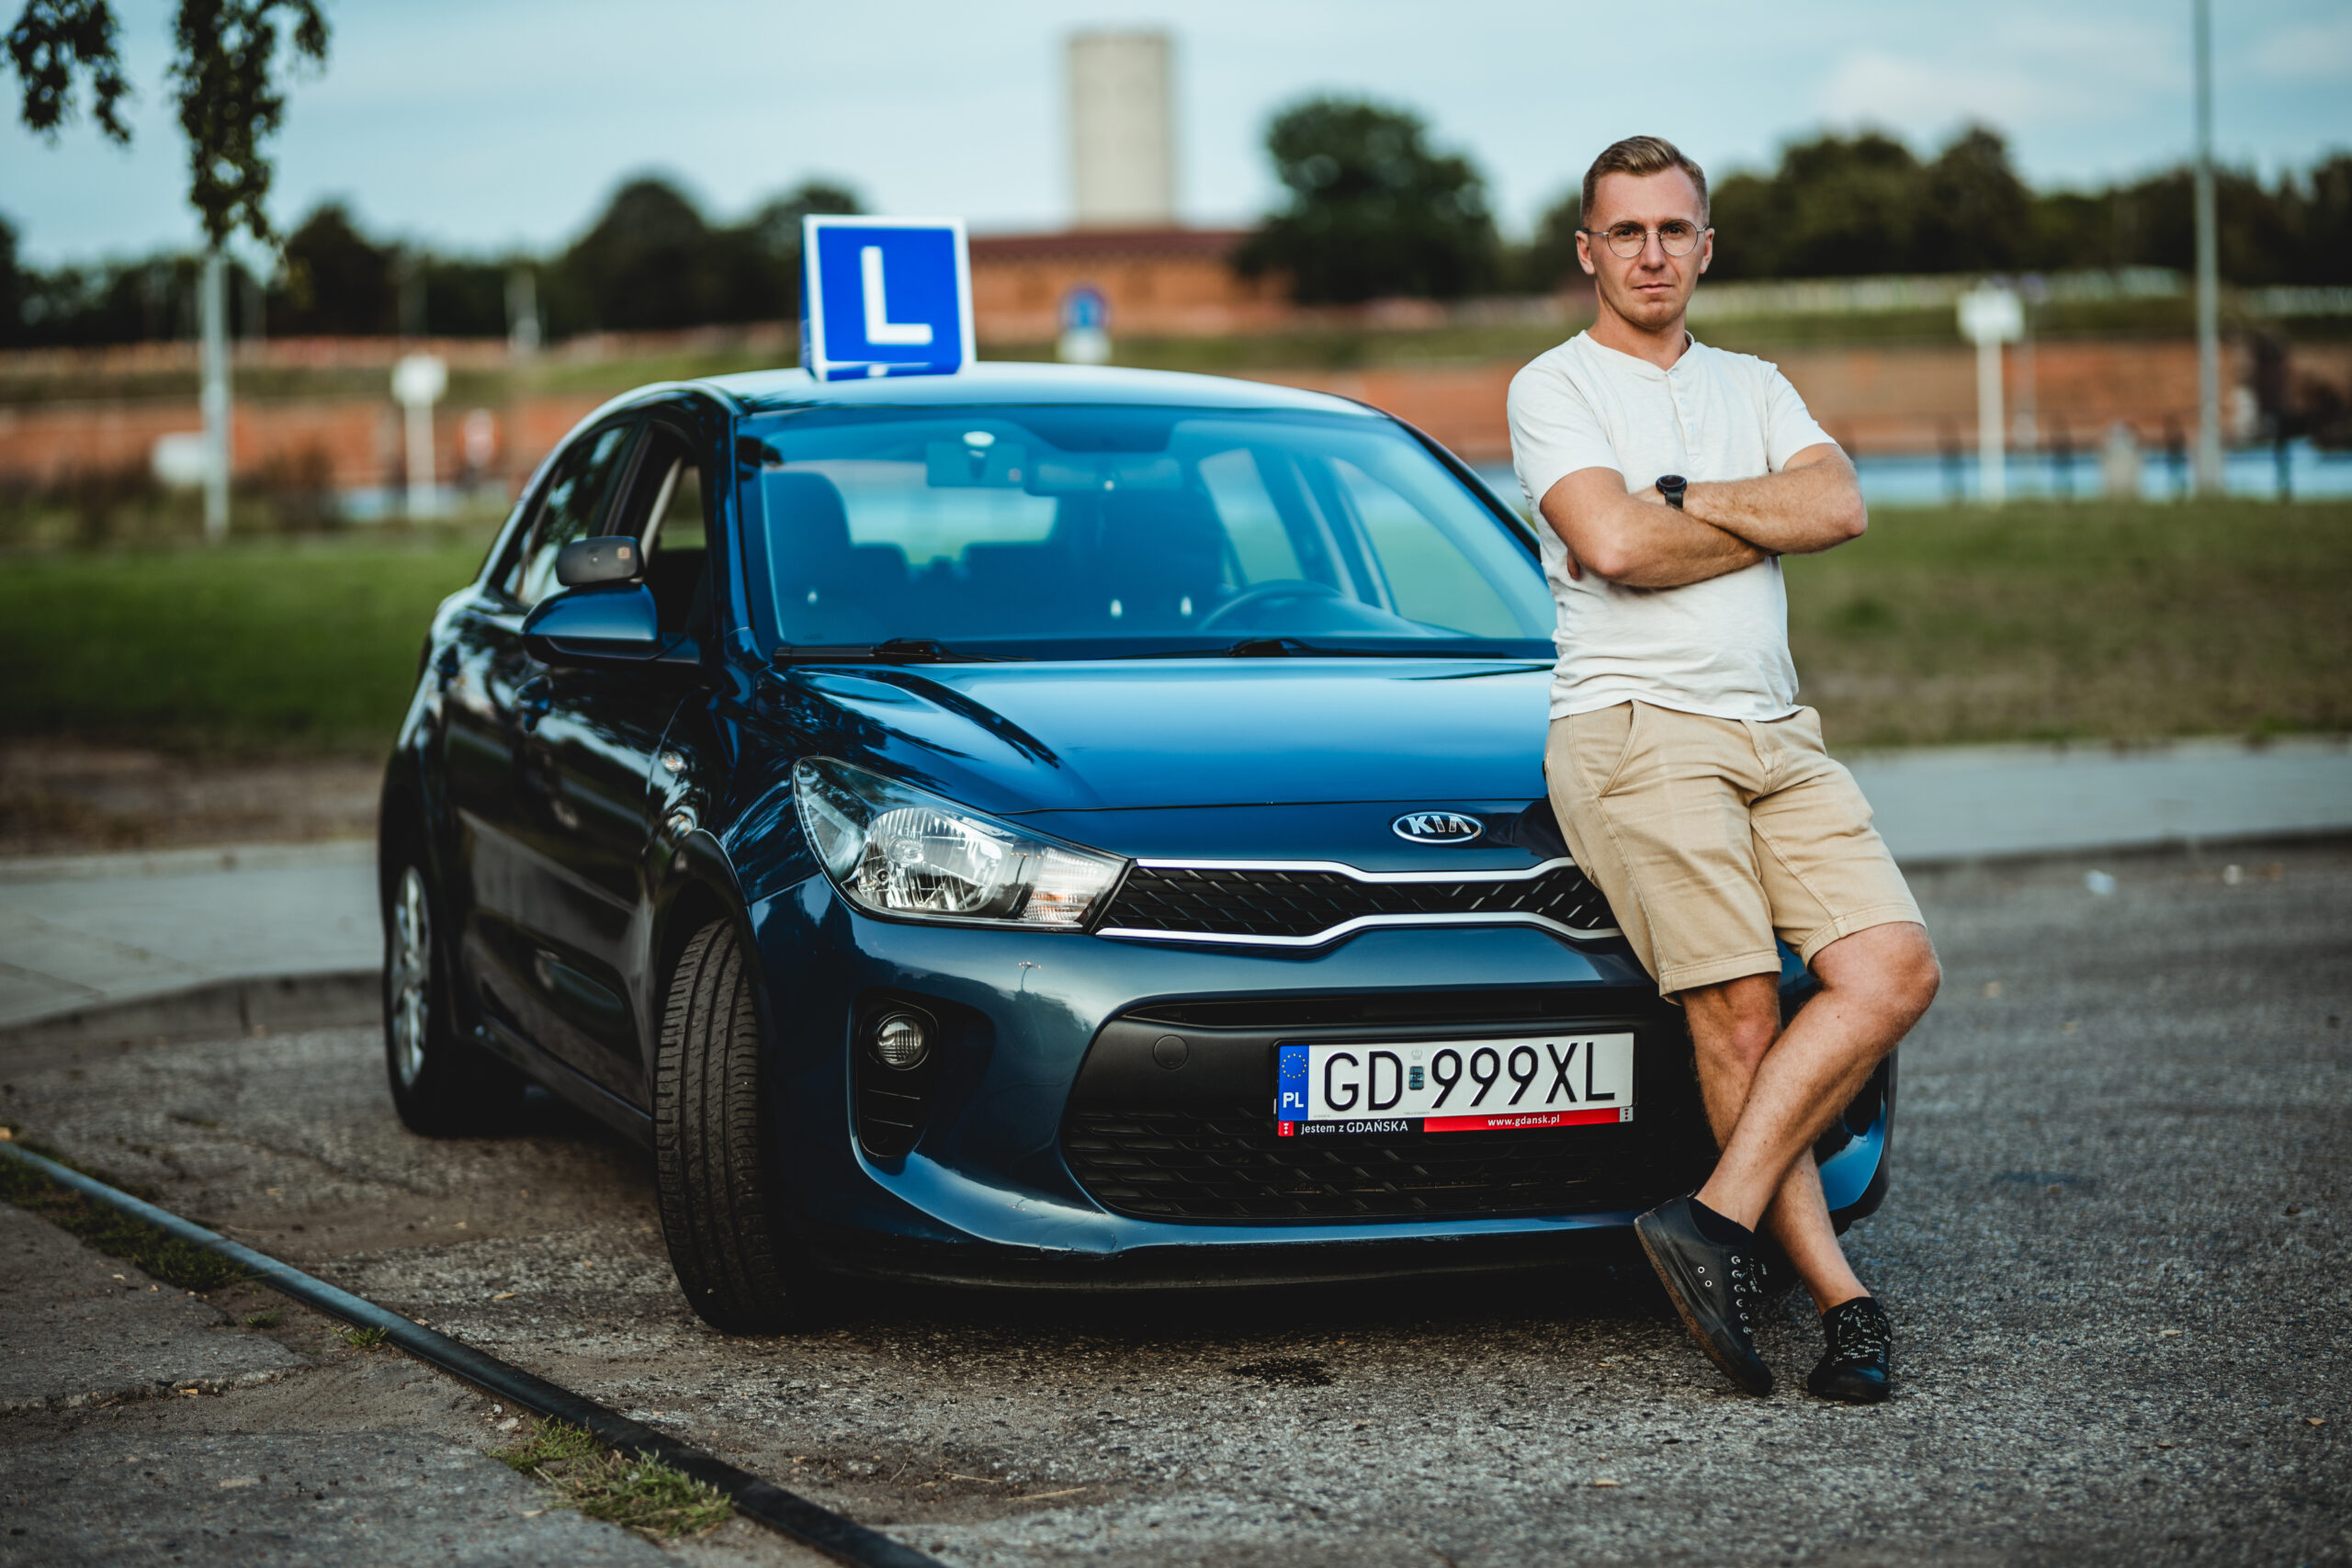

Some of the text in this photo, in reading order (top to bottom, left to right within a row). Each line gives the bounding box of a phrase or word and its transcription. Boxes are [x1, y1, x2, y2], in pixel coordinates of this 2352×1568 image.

[861, 245, 933, 344] L
[1407, 815, 1471, 834] KIA
[1324, 1042, 1615, 1111] GD 999XL
[1283, 1092, 1304, 1108] PL
[1301, 1124, 1335, 1134] jestem
[1346, 1119, 1408, 1133] GDAŃSKA
[1487, 1114, 1560, 1127] www.gdansk.pl
